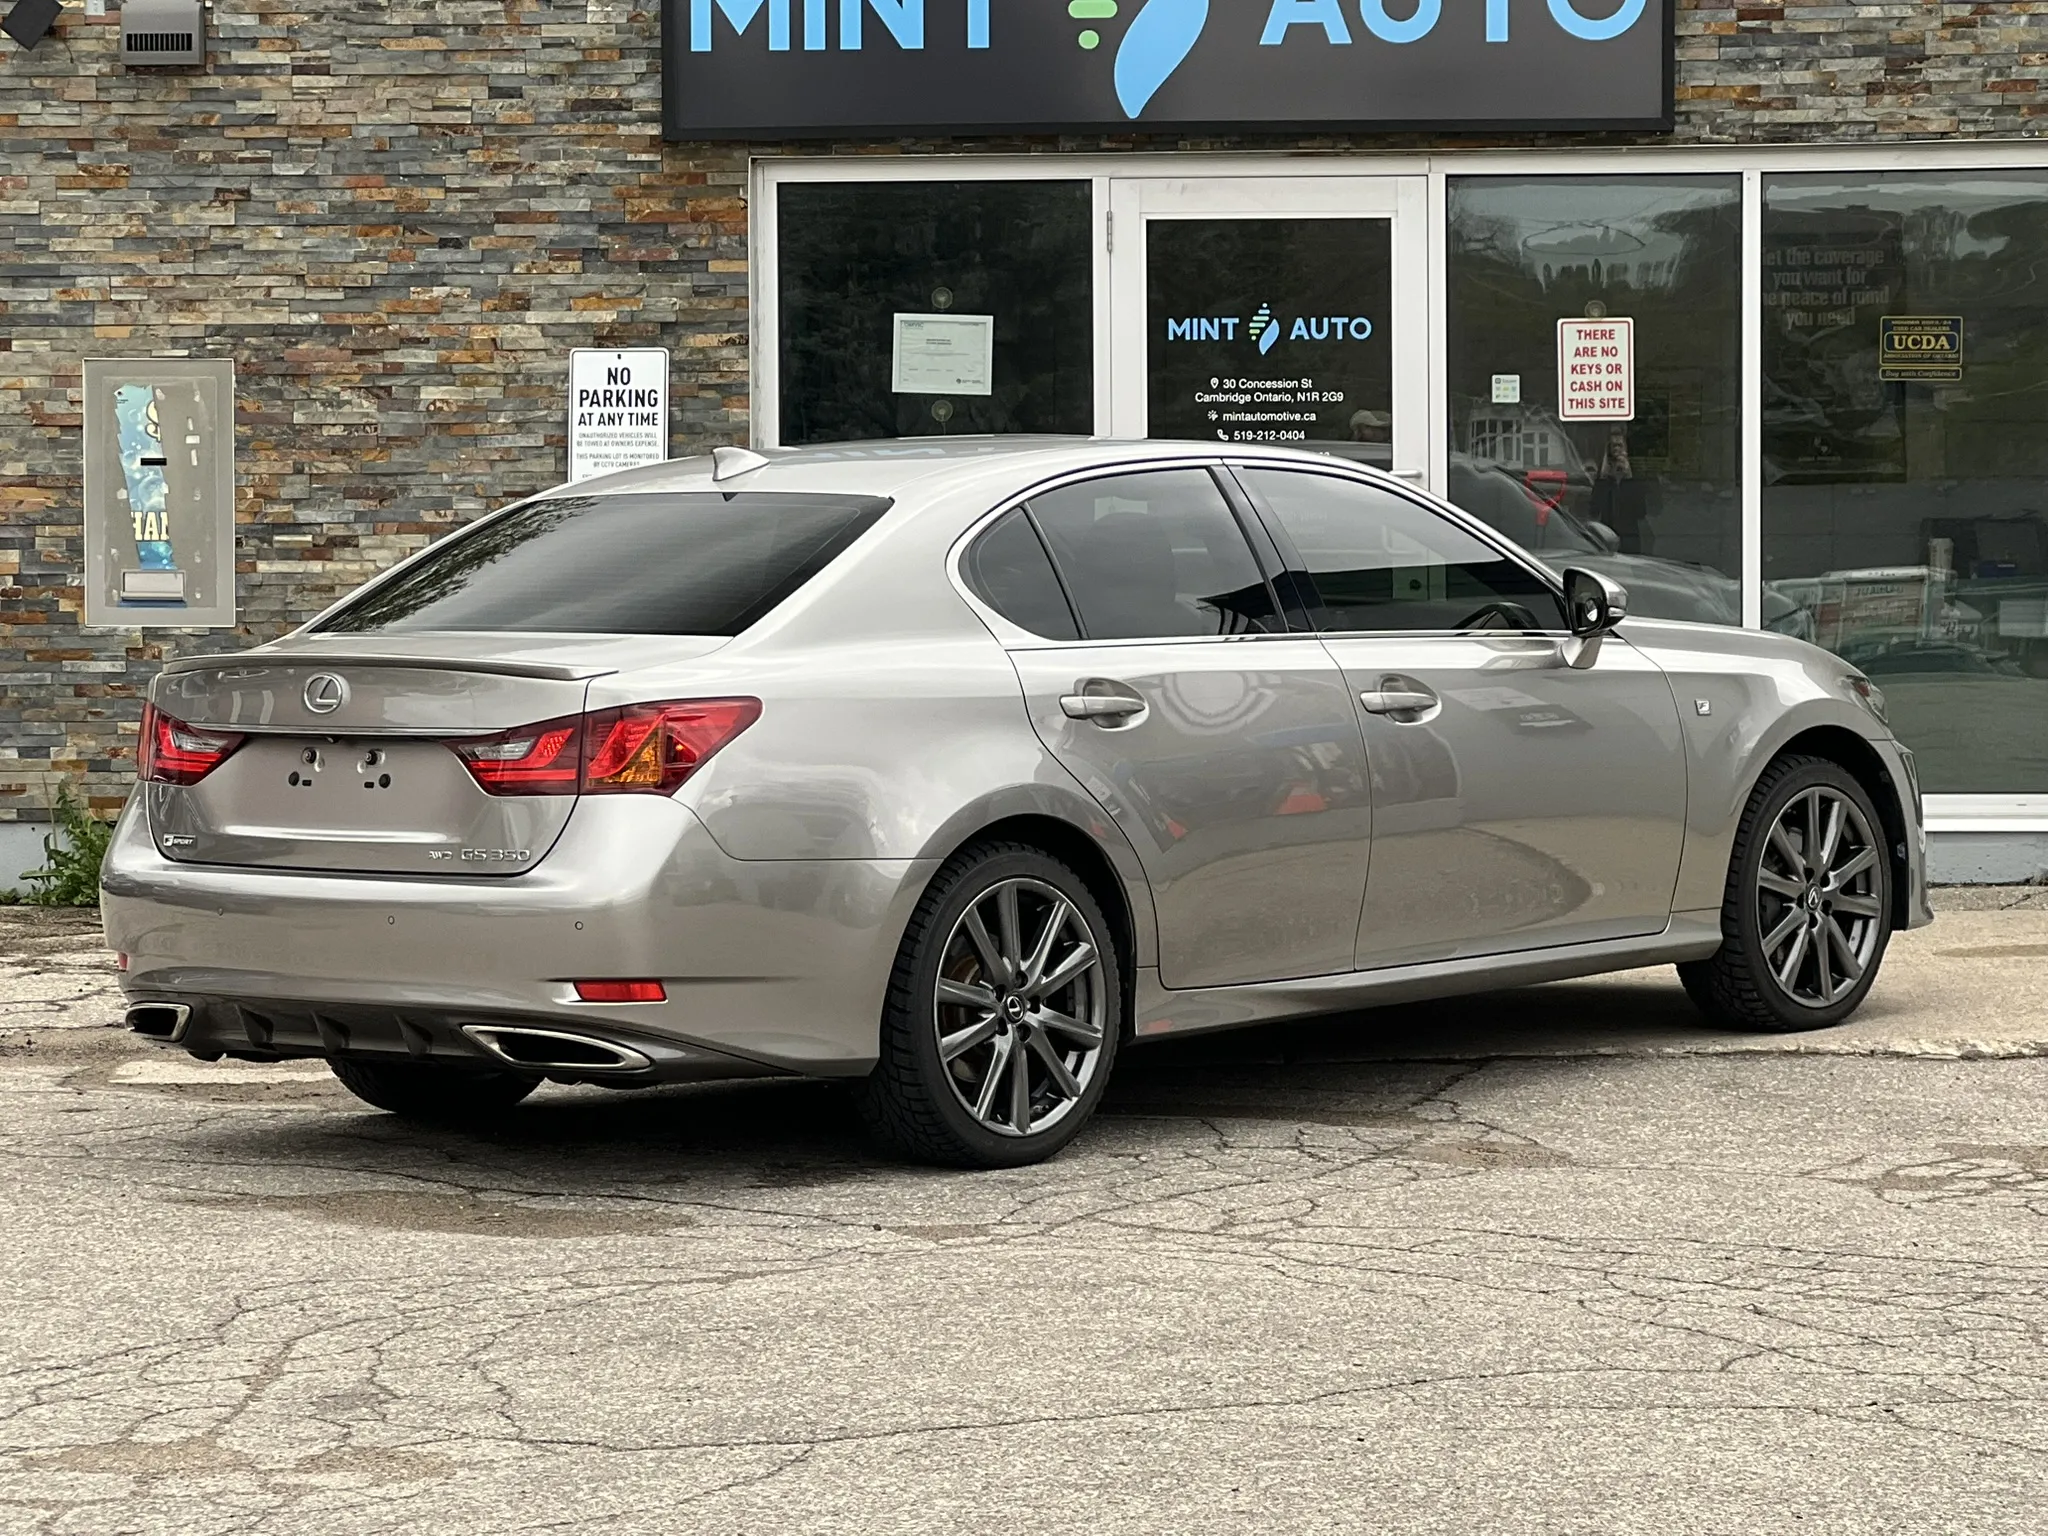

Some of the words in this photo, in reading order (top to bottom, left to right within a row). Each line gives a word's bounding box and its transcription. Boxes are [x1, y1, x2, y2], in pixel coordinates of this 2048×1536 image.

[1786, 247, 1811, 265] the
[1813, 249, 1885, 268] coverage
[1772, 271, 1802, 290] you
[1803, 269, 1844, 286] want
[1845, 267, 1868, 285] for
[1781, 291, 1829, 309] peace
[1832, 287, 1848, 305] of
[1851, 285, 1890, 304] mind
[1786, 310, 1813, 330] you
[1817, 307, 1856, 326] need
[1168, 317, 1240, 341] MINT
[1289, 317, 1372, 340] AUTO
[1576, 329, 1616, 340] THERE
[1893, 335, 1951, 349] UCDA
[1574, 346, 1597, 357] ARE
[1601, 346, 1618, 357] NO
[1571, 364, 1602, 375] KEYS
[1605, 363, 1623, 374] OR
[607, 367, 631, 386] NO
[1223, 379, 1237, 389] 30
[1238, 378, 1299, 389] Concession
[1301, 378, 1313, 389] St
[1570, 381, 1601, 392] CASH
[1605, 380, 1623, 391] ON
[579, 389, 658, 408] PARKING
[1195, 391, 1252, 404] Cambridge
[1253, 391, 1295, 403] Ontario,
[1297, 391, 1320, 402] N1R
[1321, 391, 1344, 402] 2G9
[1568, 398, 1595, 409] THIS
[1599, 397, 1625, 408] SITE
[578, 412, 594, 426] AT
[597, 412, 625, 426] ANY
[628, 412, 659, 426] TIME
[1222, 411, 1317, 421] mintautomotive.ca
[1233, 430, 1306, 441] 519-212-0404
[461, 848, 488, 861] GS
[490, 849, 531, 861] 350
